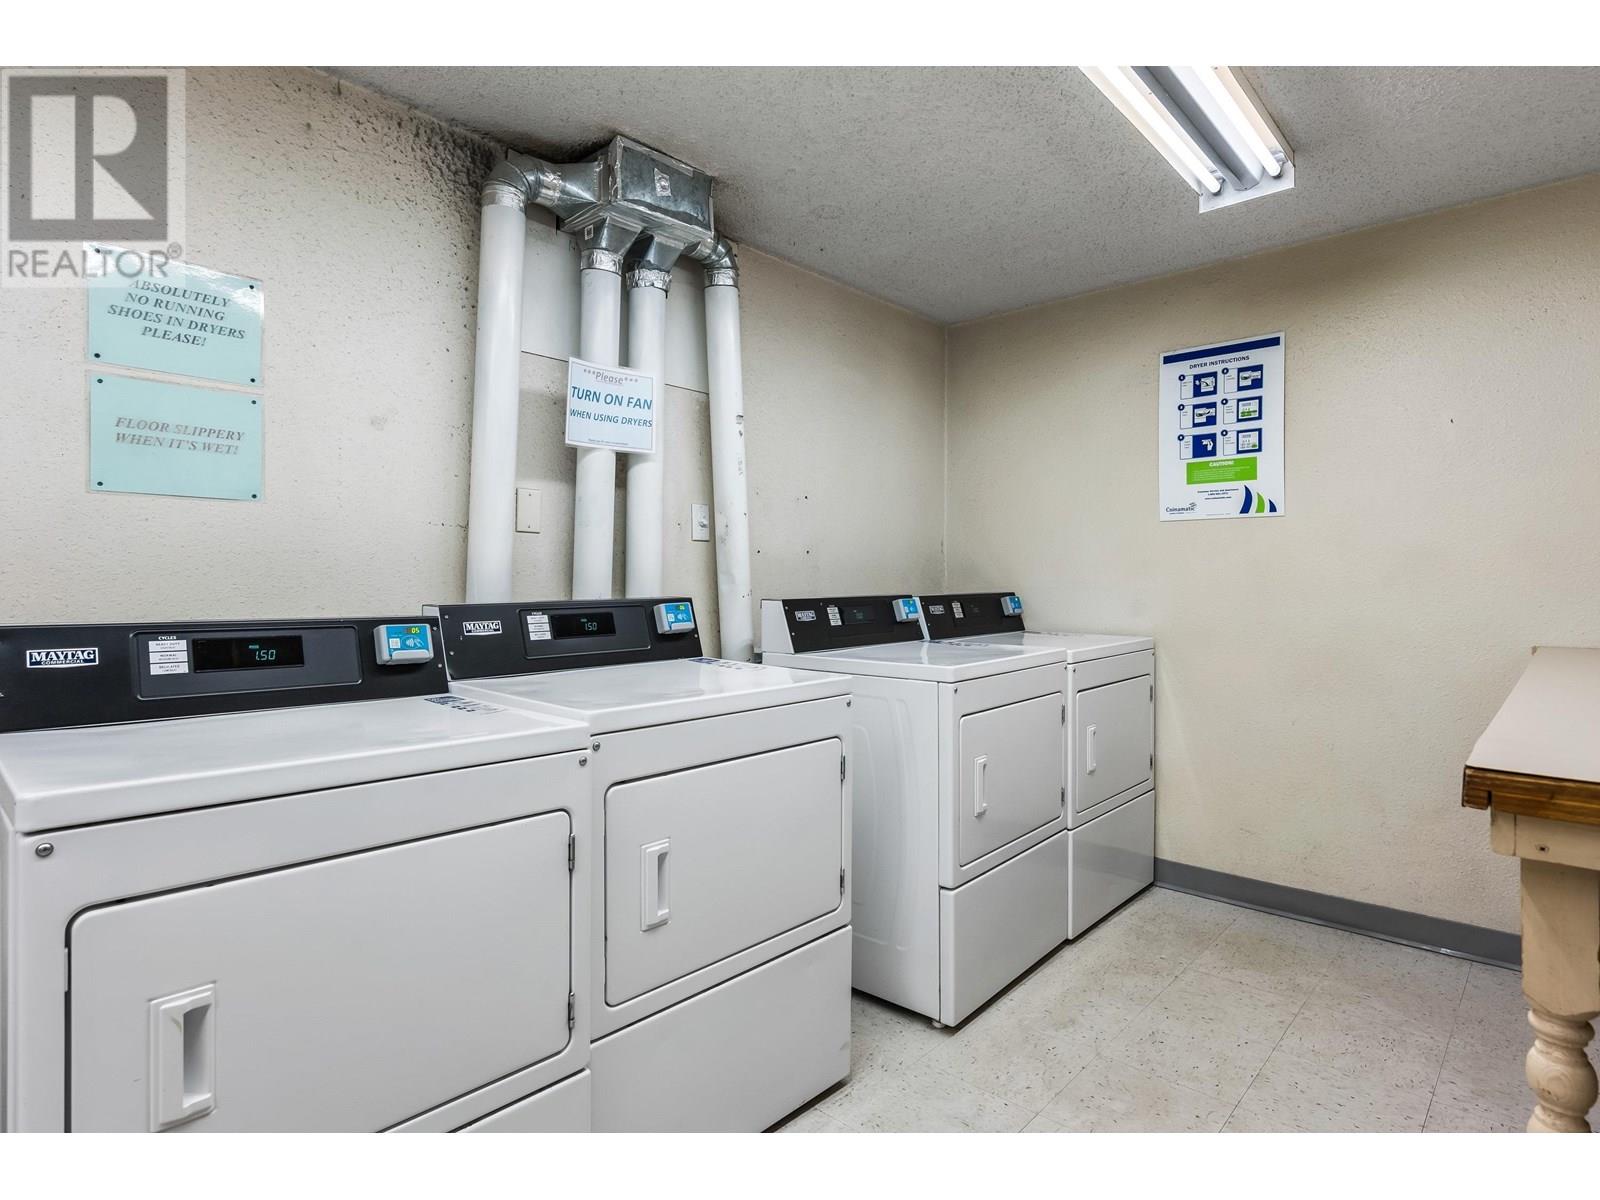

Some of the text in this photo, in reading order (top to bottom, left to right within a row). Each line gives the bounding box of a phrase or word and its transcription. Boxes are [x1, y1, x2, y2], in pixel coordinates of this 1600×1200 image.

[129, 279, 231, 308] ABSOLUTELY
[125, 292, 226, 321] NO RUNNING
[107, 304, 246, 340] SHOES IN DRYERS
[141, 326, 207, 347] PLEASE!
[1189, 355, 1250, 370] DRYER INSTRUCTIONS
[571, 386, 653, 411] TURN ON FAN
[115, 416, 245, 442] FLOOR SLIPPERY
[570, 408, 653, 428] WHEN USING DRYERS
[115, 432, 240, 456] WHEN IT'S WET!
[465, 622, 499, 631] MAYTAG
[31, 649, 95, 662] MAYTAG
